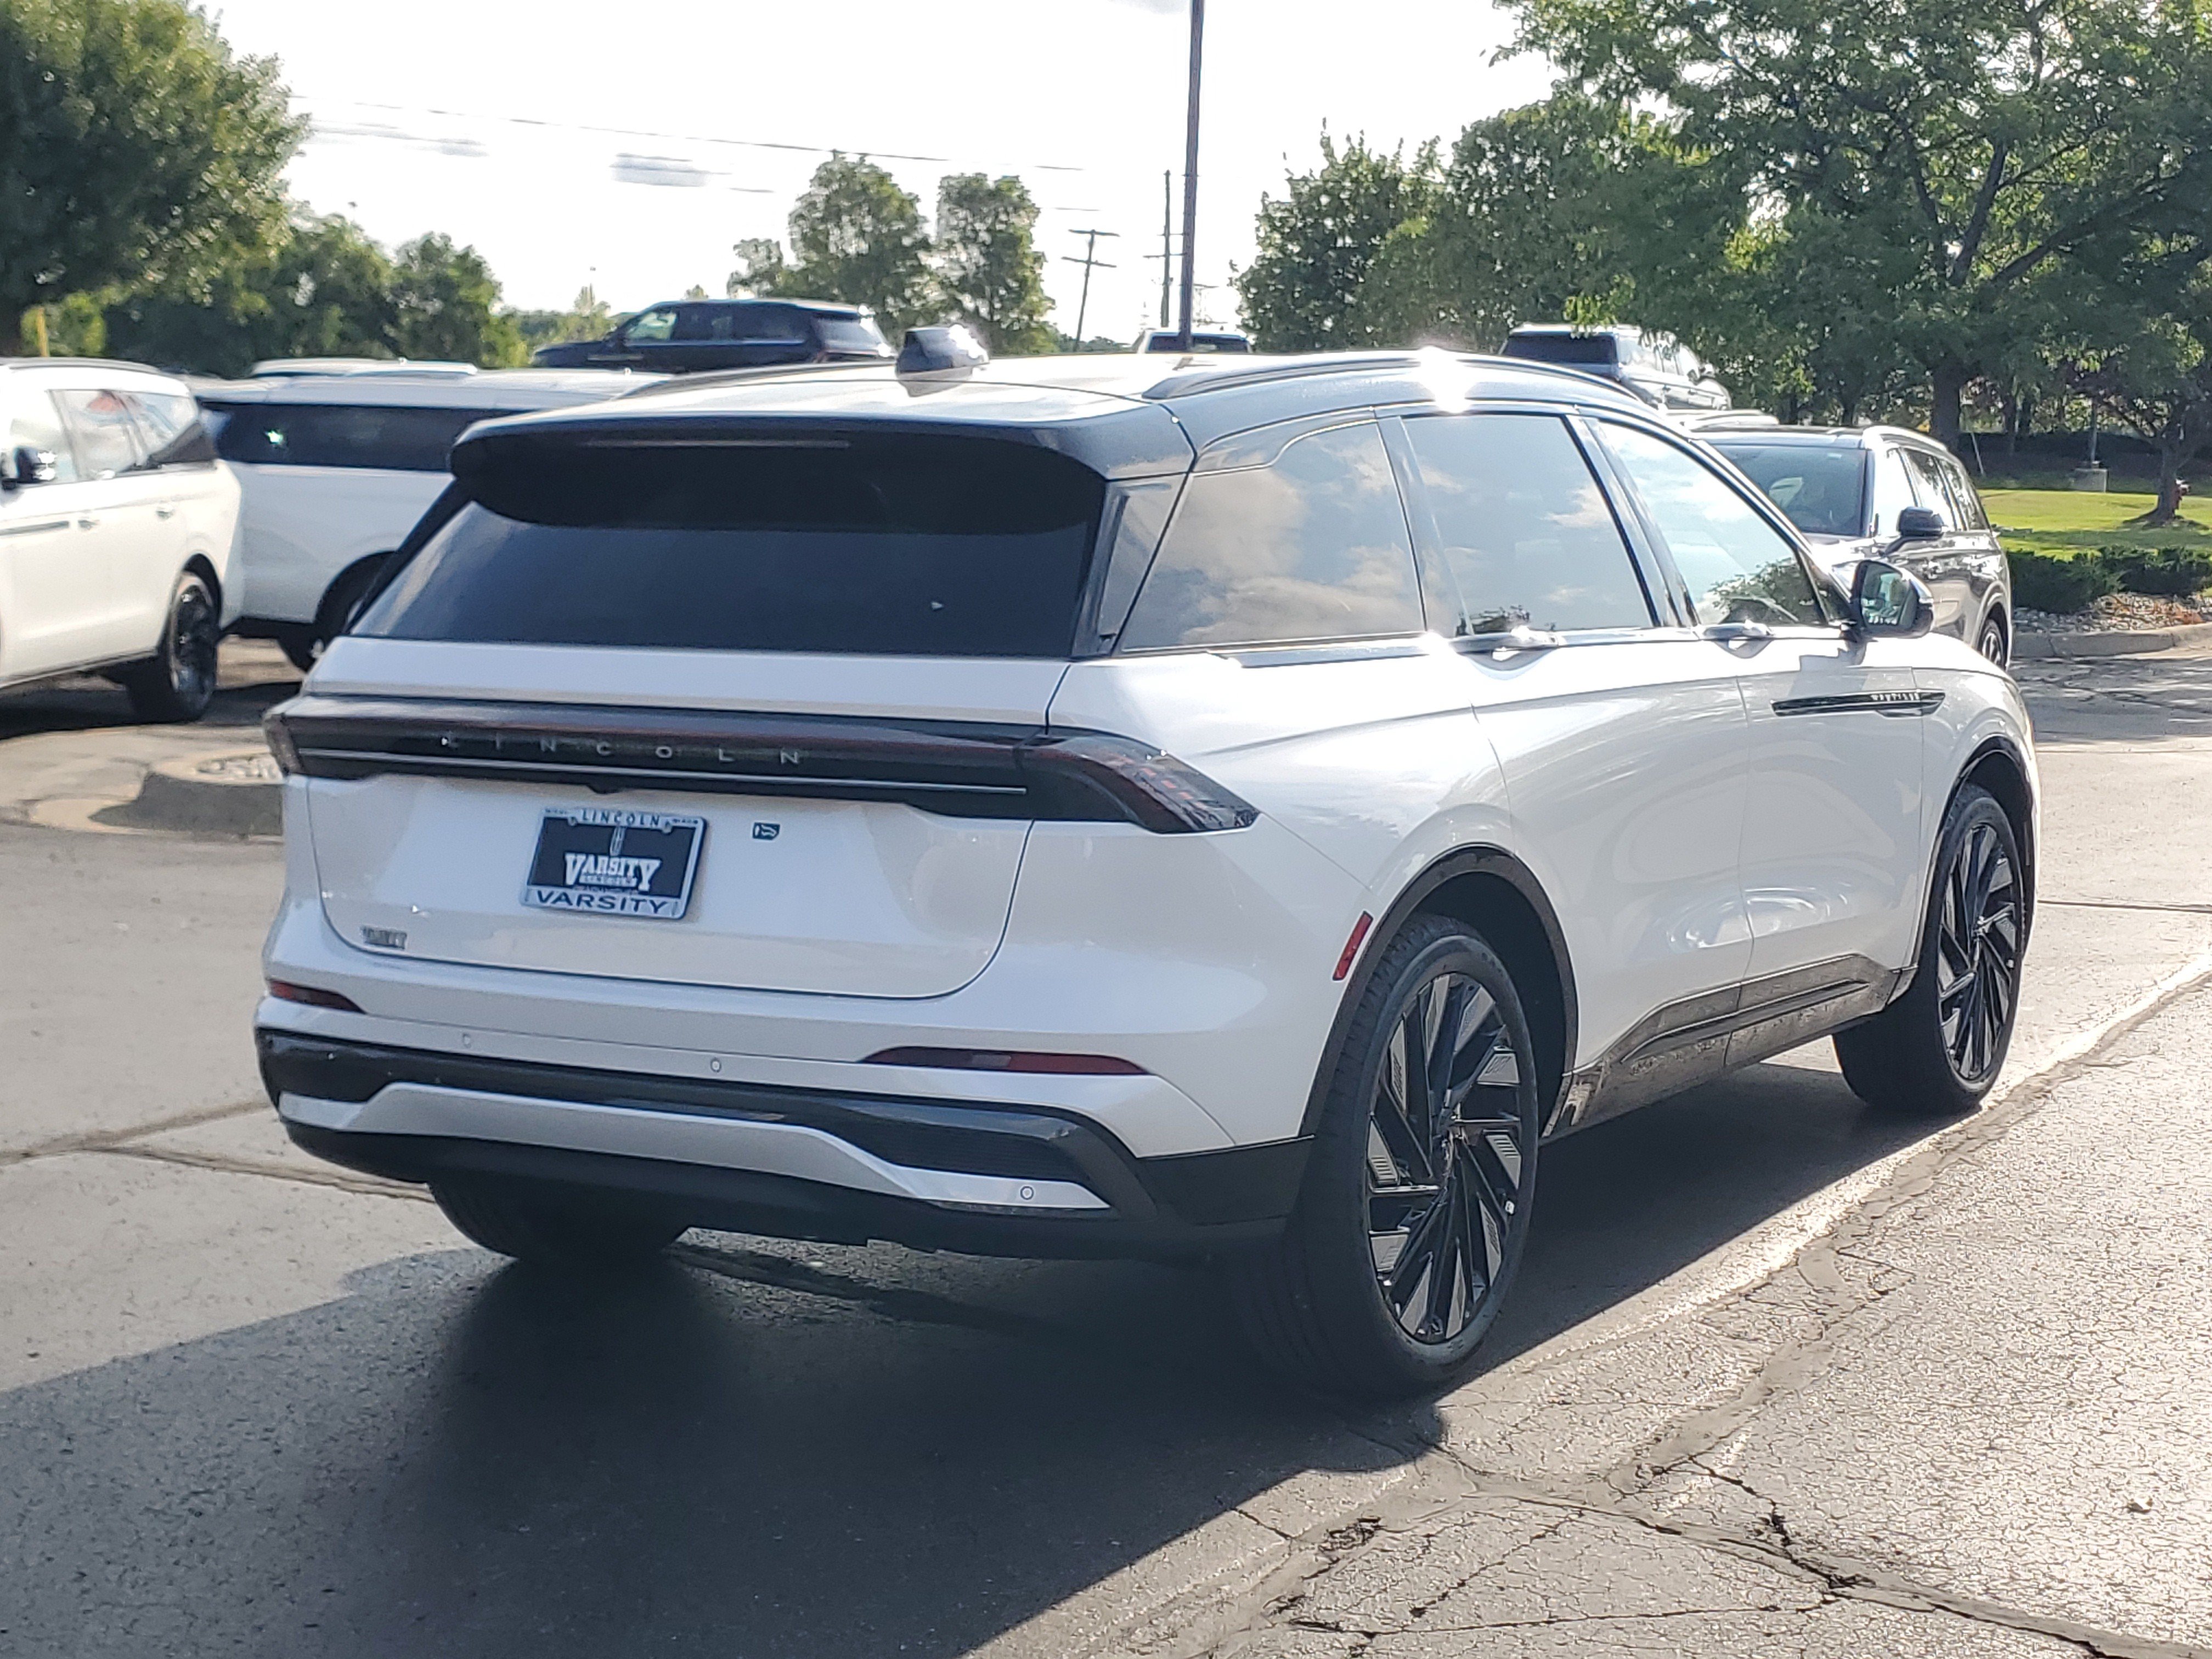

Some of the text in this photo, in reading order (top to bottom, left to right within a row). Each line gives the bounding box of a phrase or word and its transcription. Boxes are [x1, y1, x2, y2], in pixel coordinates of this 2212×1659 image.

[441, 730, 799, 765] LINCOLN
[582, 809, 661, 827] LINCOLN
[564, 853, 662, 891] VARSITY
[537, 890, 668, 914] VARSITY
